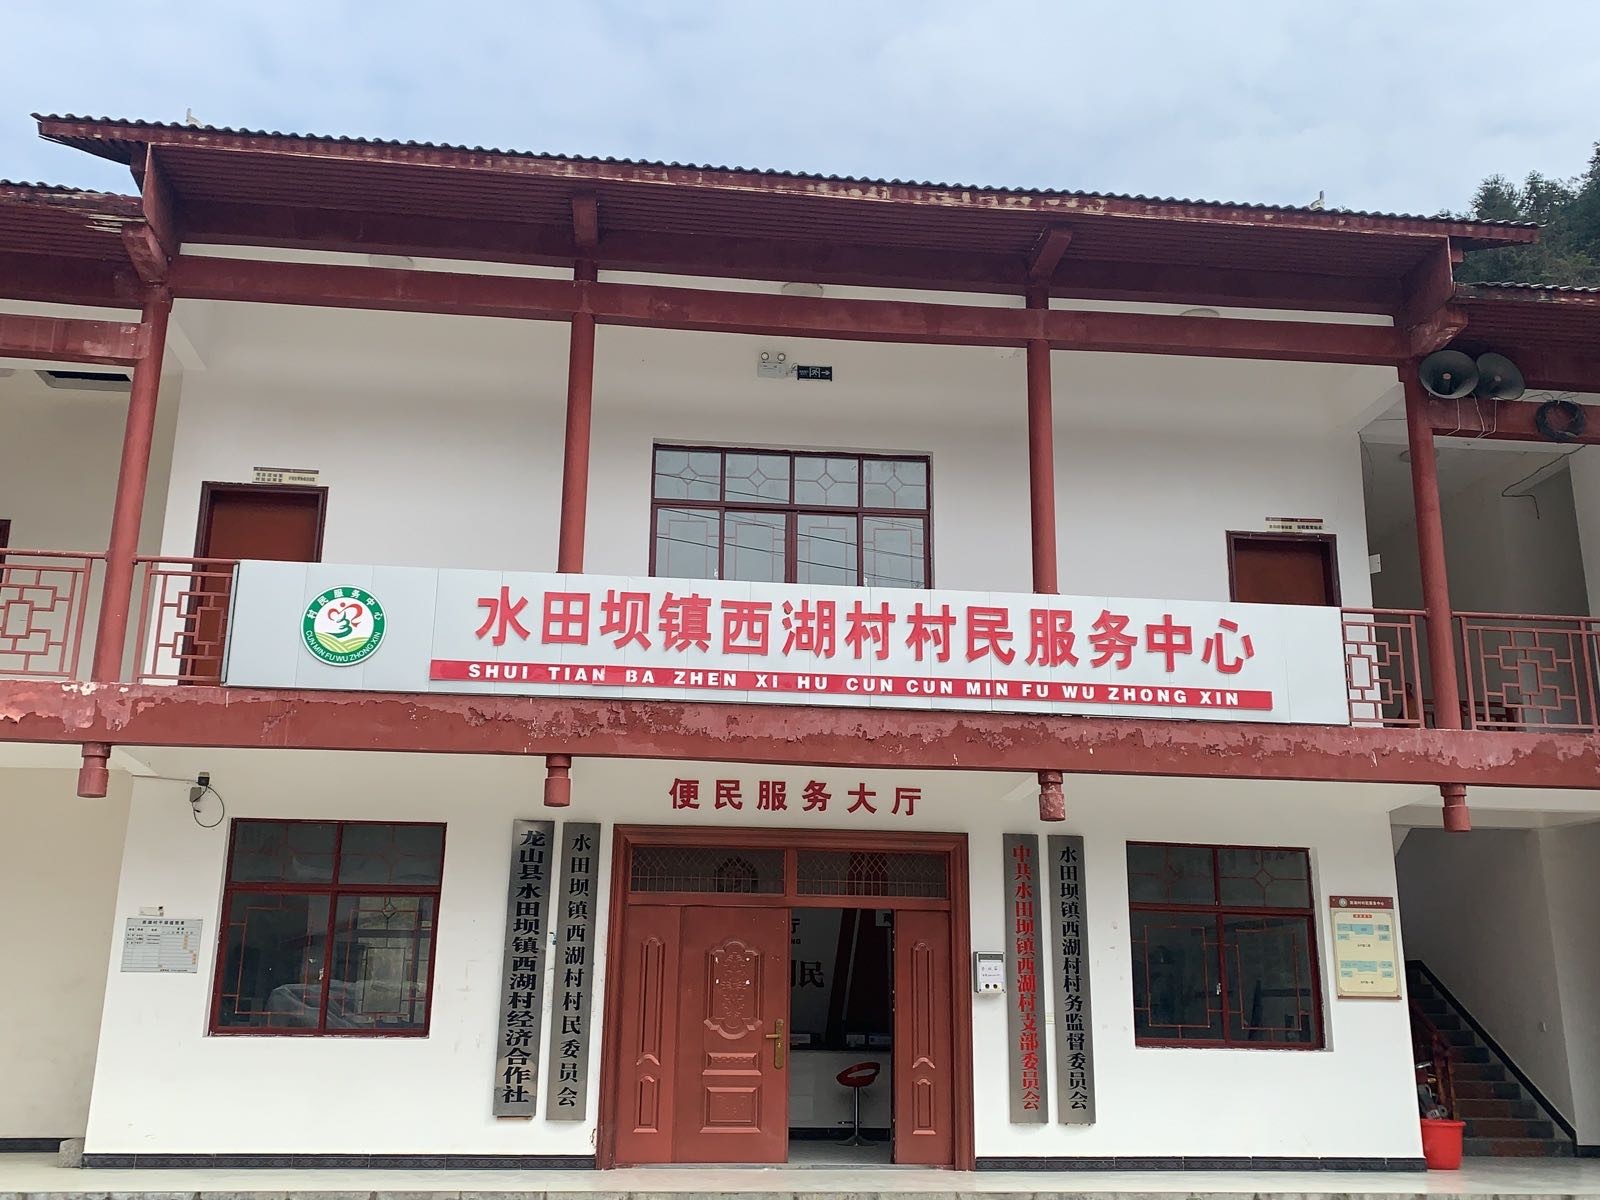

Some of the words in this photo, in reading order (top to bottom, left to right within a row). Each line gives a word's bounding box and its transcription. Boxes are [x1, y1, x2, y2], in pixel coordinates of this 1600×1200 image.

[305, 630, 316, 645] CUN
[313, 643, 325, 656] MIN
[324, 652, 335, 661] FU
[350, 644, 374, 661] ZHONG
[372, 631, 381, 646] XIN
[306, 589, 382, 620] 村民服务中心
[475, 585, 1255, 676] 水田坝镇西湖村村民服务中心
[468, 664, 528, 679] SHUI
[548, 666, 605, 682] TIAN
[625, 669, 655, 683] BA
[673, 671, 737, 687] ZHEN
[755, 674, 777, 688] XI
[797, 676, 827, 690] HU
[846, 677, 893, 692] CUN
[906, 679, 953, 694] CUN
[966, 681, 1008, 696] MIN
[1022, 683, 1048, 698] FU
[1062, 685, 1095, 700] WU
[1108, 687, 1187, 704] ZHONG
[1200, 691, 1238, 706] XIN
[668, 778, 922, 816] 便民服务大厅
[502, 829, 546, 1104] 龙山县水田坝镇西湖村经济合作社
[557, 833, 591, 1107] 水田坝镇西湖村村民委员会
[1012, 844, 1041, 1111] 中共水田坝镇西湖村支部委员会
[1059, 846, 1088, 1110] 水田坝镇西湖村村务监督委员会
